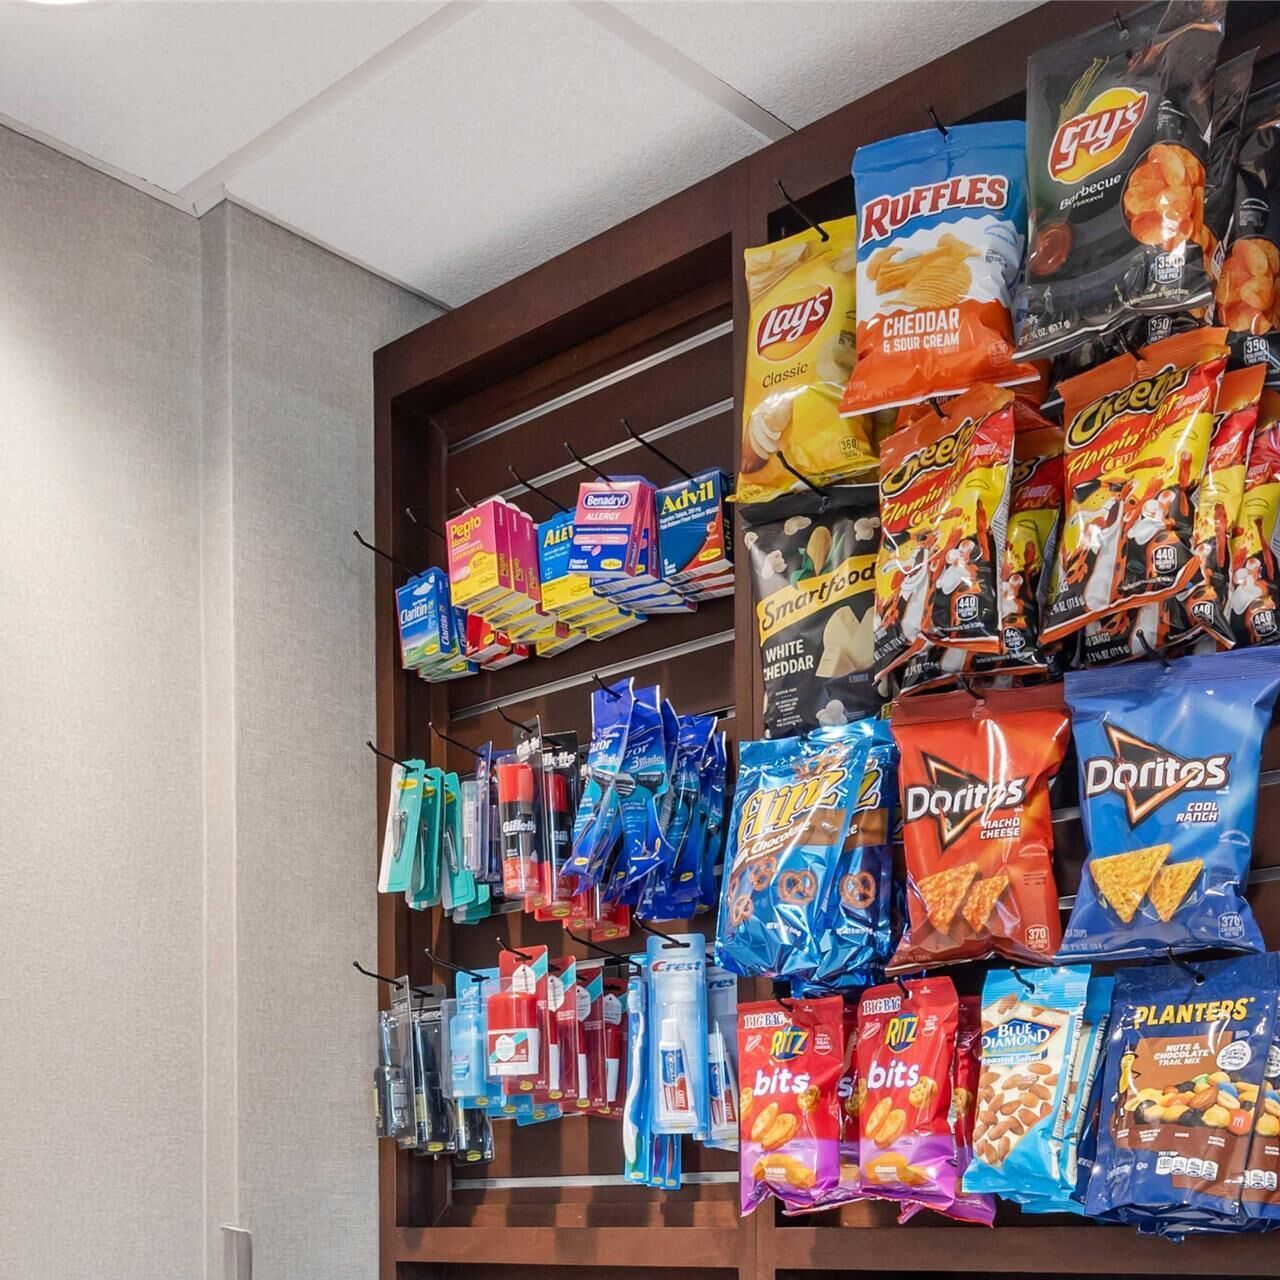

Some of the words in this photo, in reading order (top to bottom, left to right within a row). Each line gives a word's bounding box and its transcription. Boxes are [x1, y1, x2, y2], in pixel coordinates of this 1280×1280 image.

[1055, 100, 1145, 170] Lay's
[1059, 174, 1122, 210] Barbecue
[862, 177, 1007, 244] RUFFLES
[762, 293, 829, 346] Lay's
[883, 308, 960, 338] CHEDDAR
[883, 341, 890, 353] &
[894, 337, 919, 351] SOUR
[923, 332, 960, 349] CREAM
[762, 362, 808, 388] Classic
[587, 494, 627, 506] Benadryl
[661, 481, 715, 515] Advil
[450, 516, 481, 537] Pepto
[585, 512, 620, 520] ALLERGY
[761, 562, 875, 631] Smartfood
[400, 603, 428, 625] Claritin
[766, 639, 804, 663] WHITE
[1087, 757, 1226, 793] Doritos
[907, 779, 1024, 820] Doritos
[1187, 803, 1217, 813] COOL
[983, 818, 1020, 828] NACHO
[1176, 812, 1217, 822] RANCH
[980, 828, 1020, 839] CHEESE
[651, 961, 701, 972] Crest
[1134, 999, 1249, 1028] PLANTERS
[983, 1031, 1050, 1048] DIAMOND
[998, 1023, 1032, 1037] BLUE
[771, 1030, 809, 1055] RITZ
[1166, 1044, 1191, 1053] NUTS
[1154, 1050, 1208, 1060] CHOCOLATE
[1158, 1058, 1181, 1066] TRAIL
[754, 1068, 809, 1096] bits
